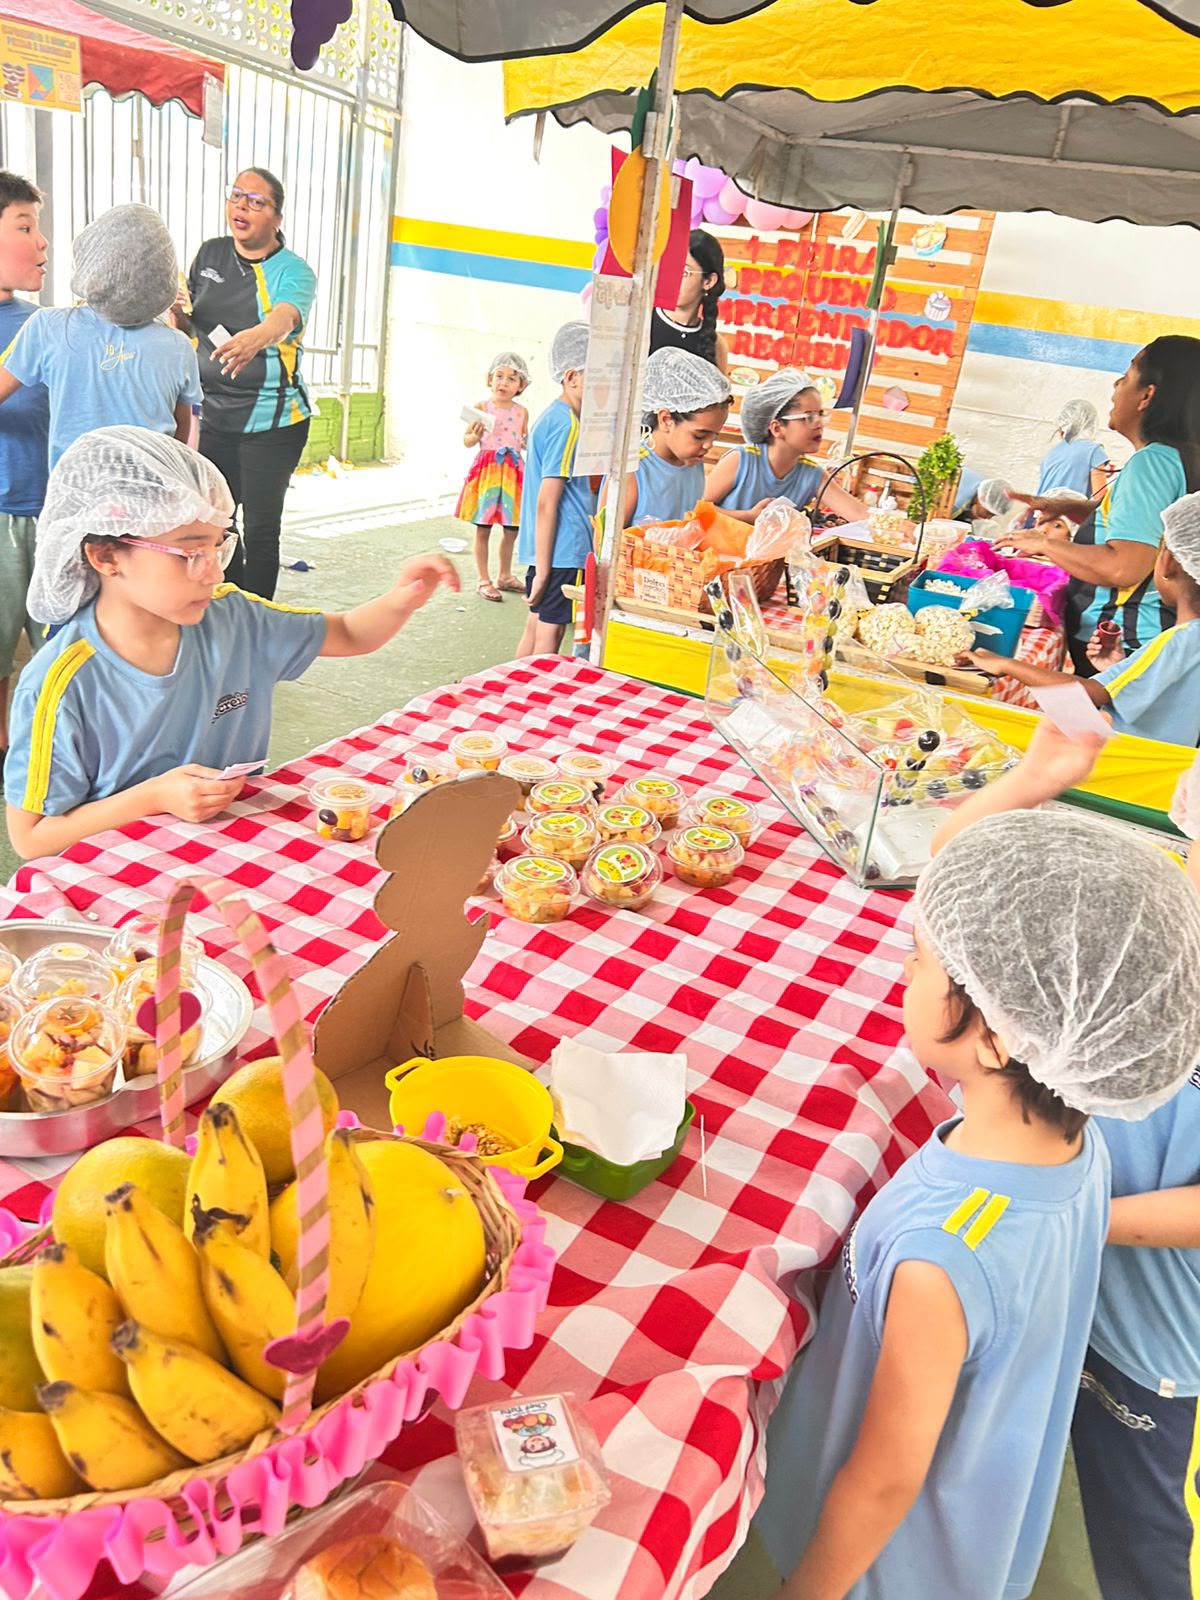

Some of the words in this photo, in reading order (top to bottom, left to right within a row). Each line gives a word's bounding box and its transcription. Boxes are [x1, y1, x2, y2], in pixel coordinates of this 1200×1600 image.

[773, 239, 878, 275] FEIRA
[738, 266, 897, 312] PEQUENO
[697, 297, 955, 358] MPREENDEDOR
